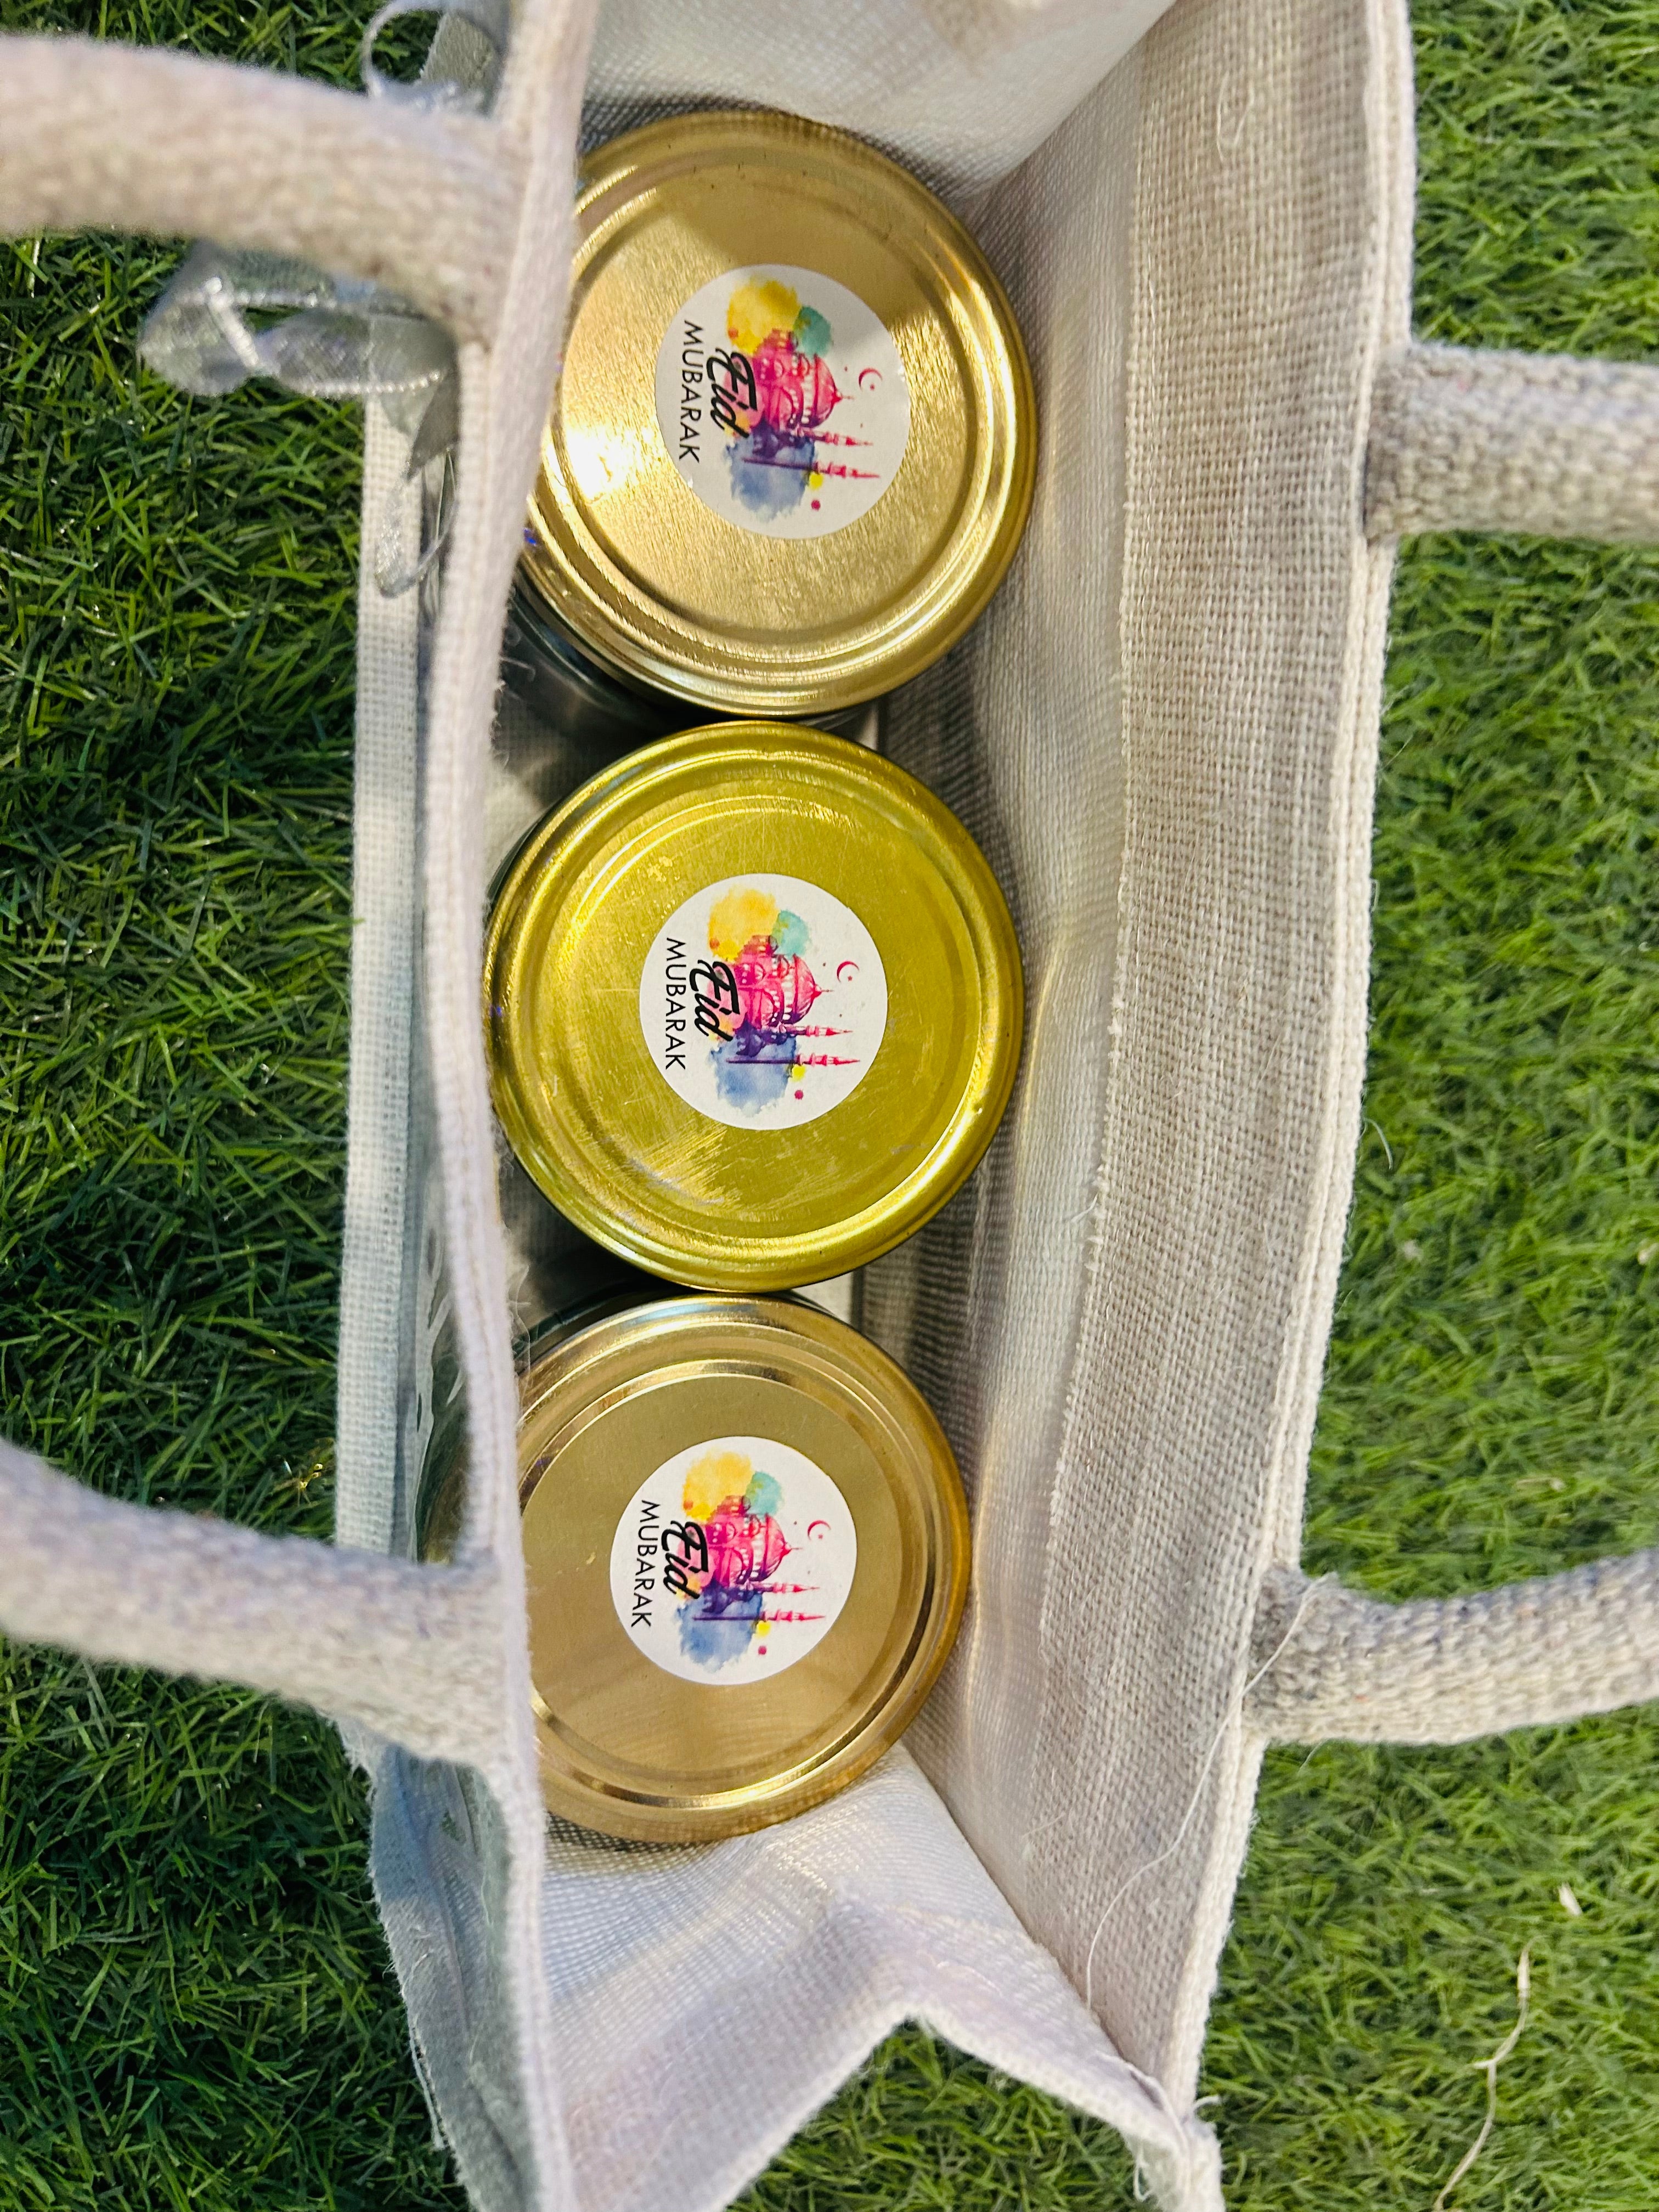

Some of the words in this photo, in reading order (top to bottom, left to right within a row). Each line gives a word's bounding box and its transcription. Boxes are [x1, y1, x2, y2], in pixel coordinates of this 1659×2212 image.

[679, 319, 704, 464] MUBARAK
[706, 347, 758, 438] Eid
[665, 937, 687, 1071] MUBARAK
[689, 959, 741, 1042] Eid
[631, 1499, 661, 1628] MUBARAK
[661, 1520, 709, 1600] Eid
